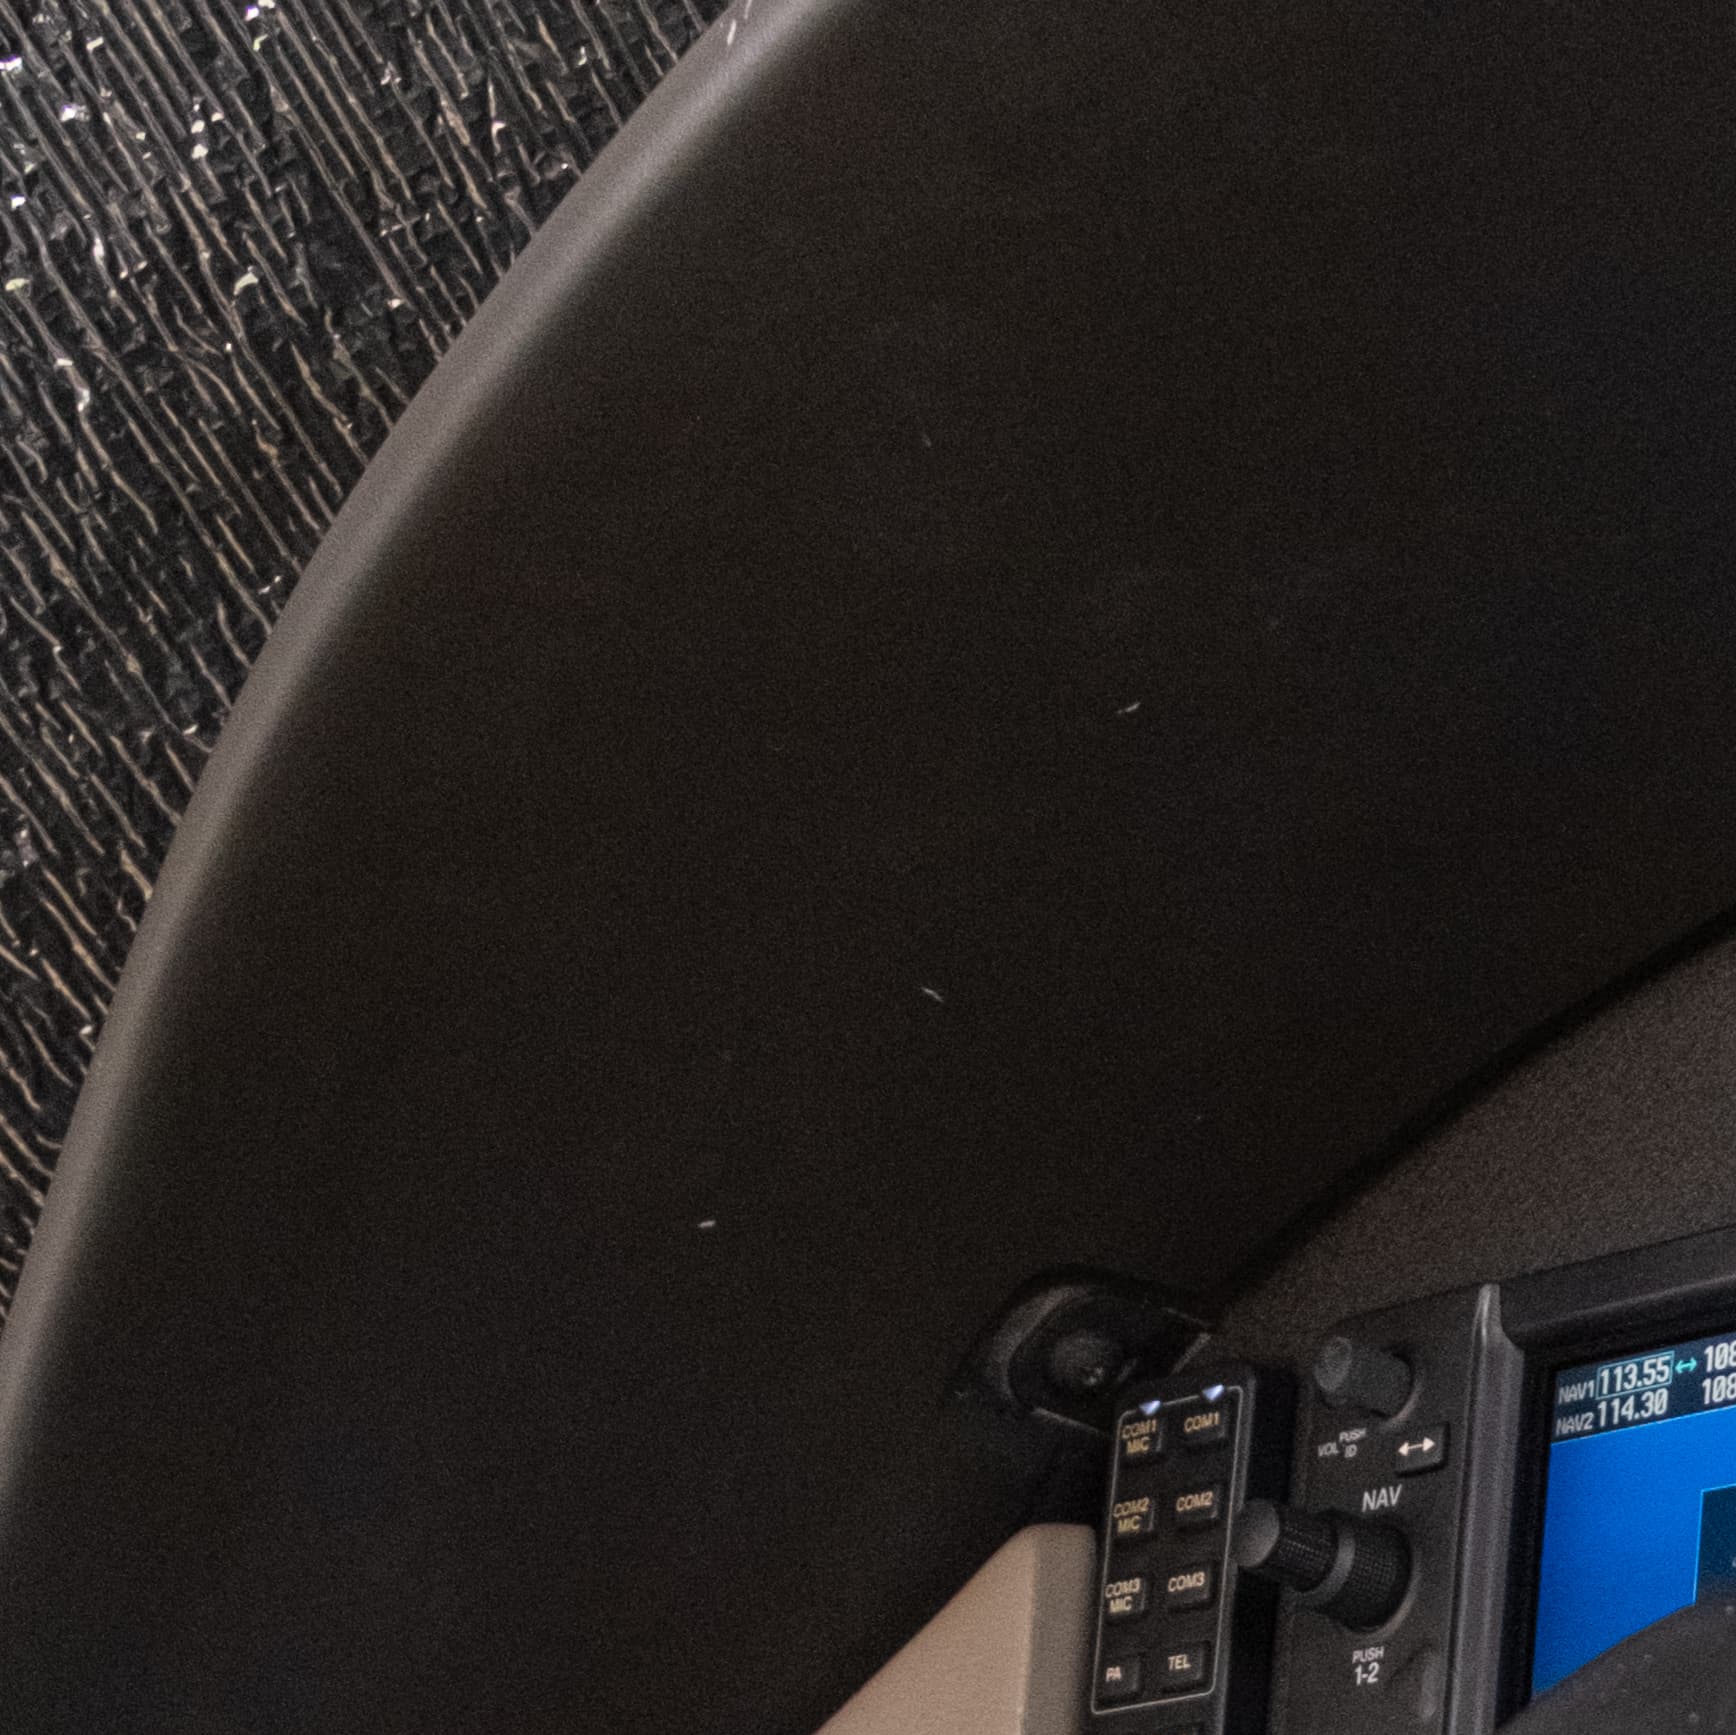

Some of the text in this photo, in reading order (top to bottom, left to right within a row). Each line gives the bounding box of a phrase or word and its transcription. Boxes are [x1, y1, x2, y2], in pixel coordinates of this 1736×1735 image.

[1559, 1381, 1595, 1403] NAV1
[1600, 1356, 1672, 1396] 113.55
[1598, 1388, 1669, 1428] 114.30
[1362, 1485, 1402, 1512] NAV
[1168, 1572, 1206, 1592] COM3
[1352, 1647, 1384, 1663] PUSH
